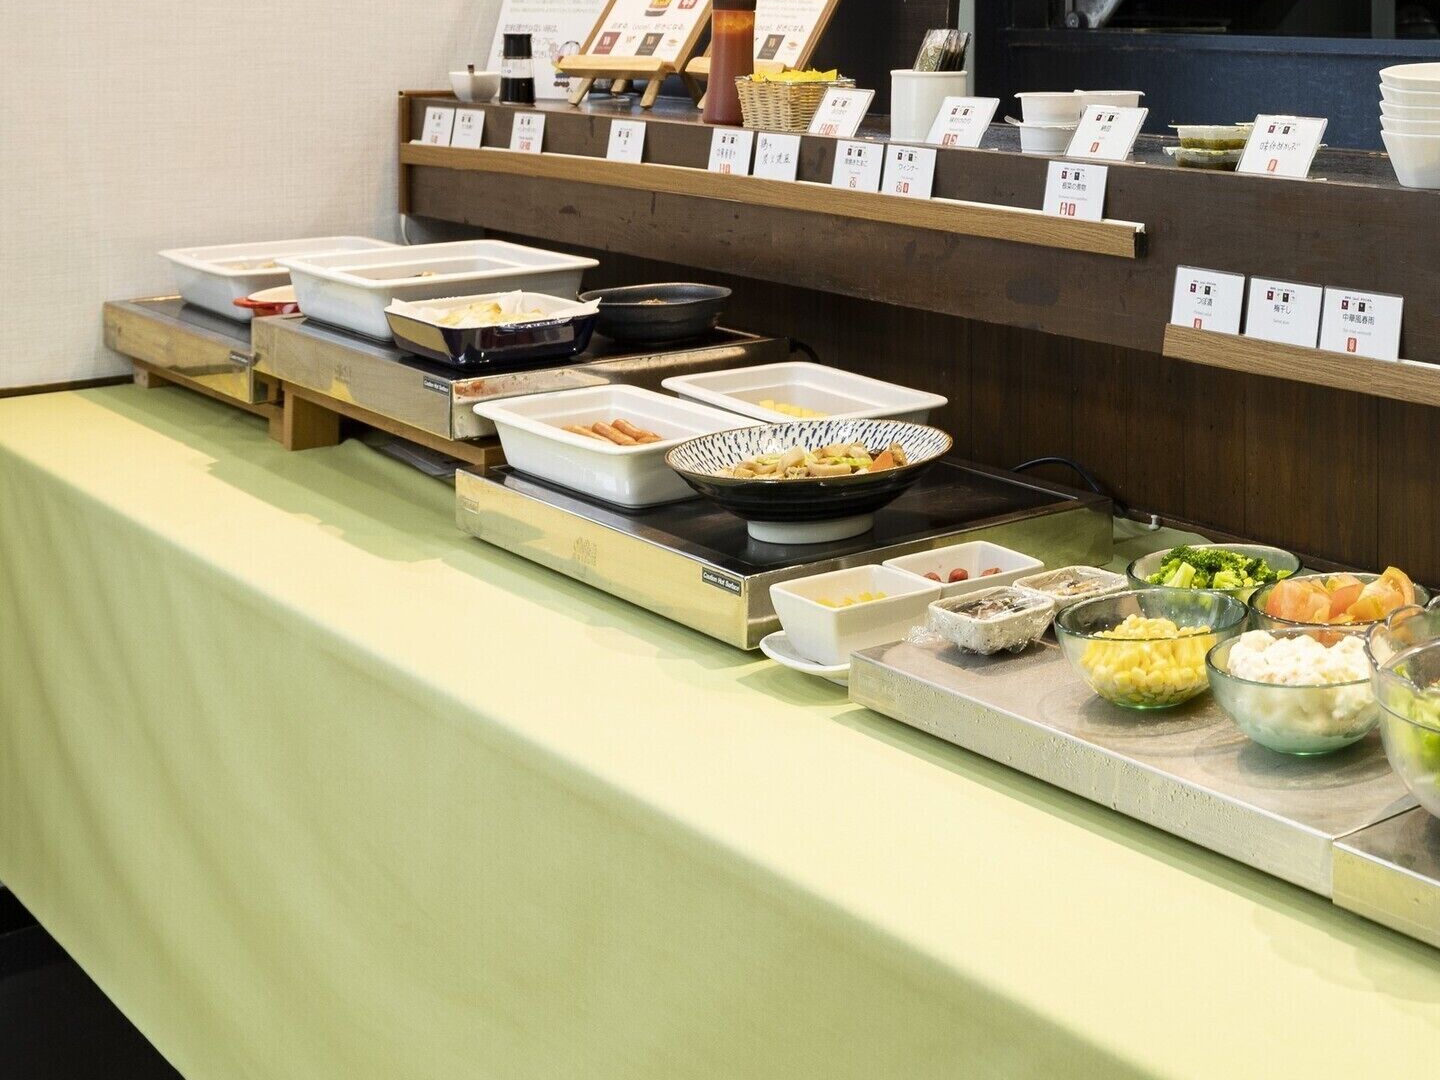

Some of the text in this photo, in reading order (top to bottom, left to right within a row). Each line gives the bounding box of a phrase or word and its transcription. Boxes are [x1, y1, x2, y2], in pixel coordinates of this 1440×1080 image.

[1273, 304, 1292, 315] 梅干し
[1342, 313, 1375, 326] 中華風春雨
